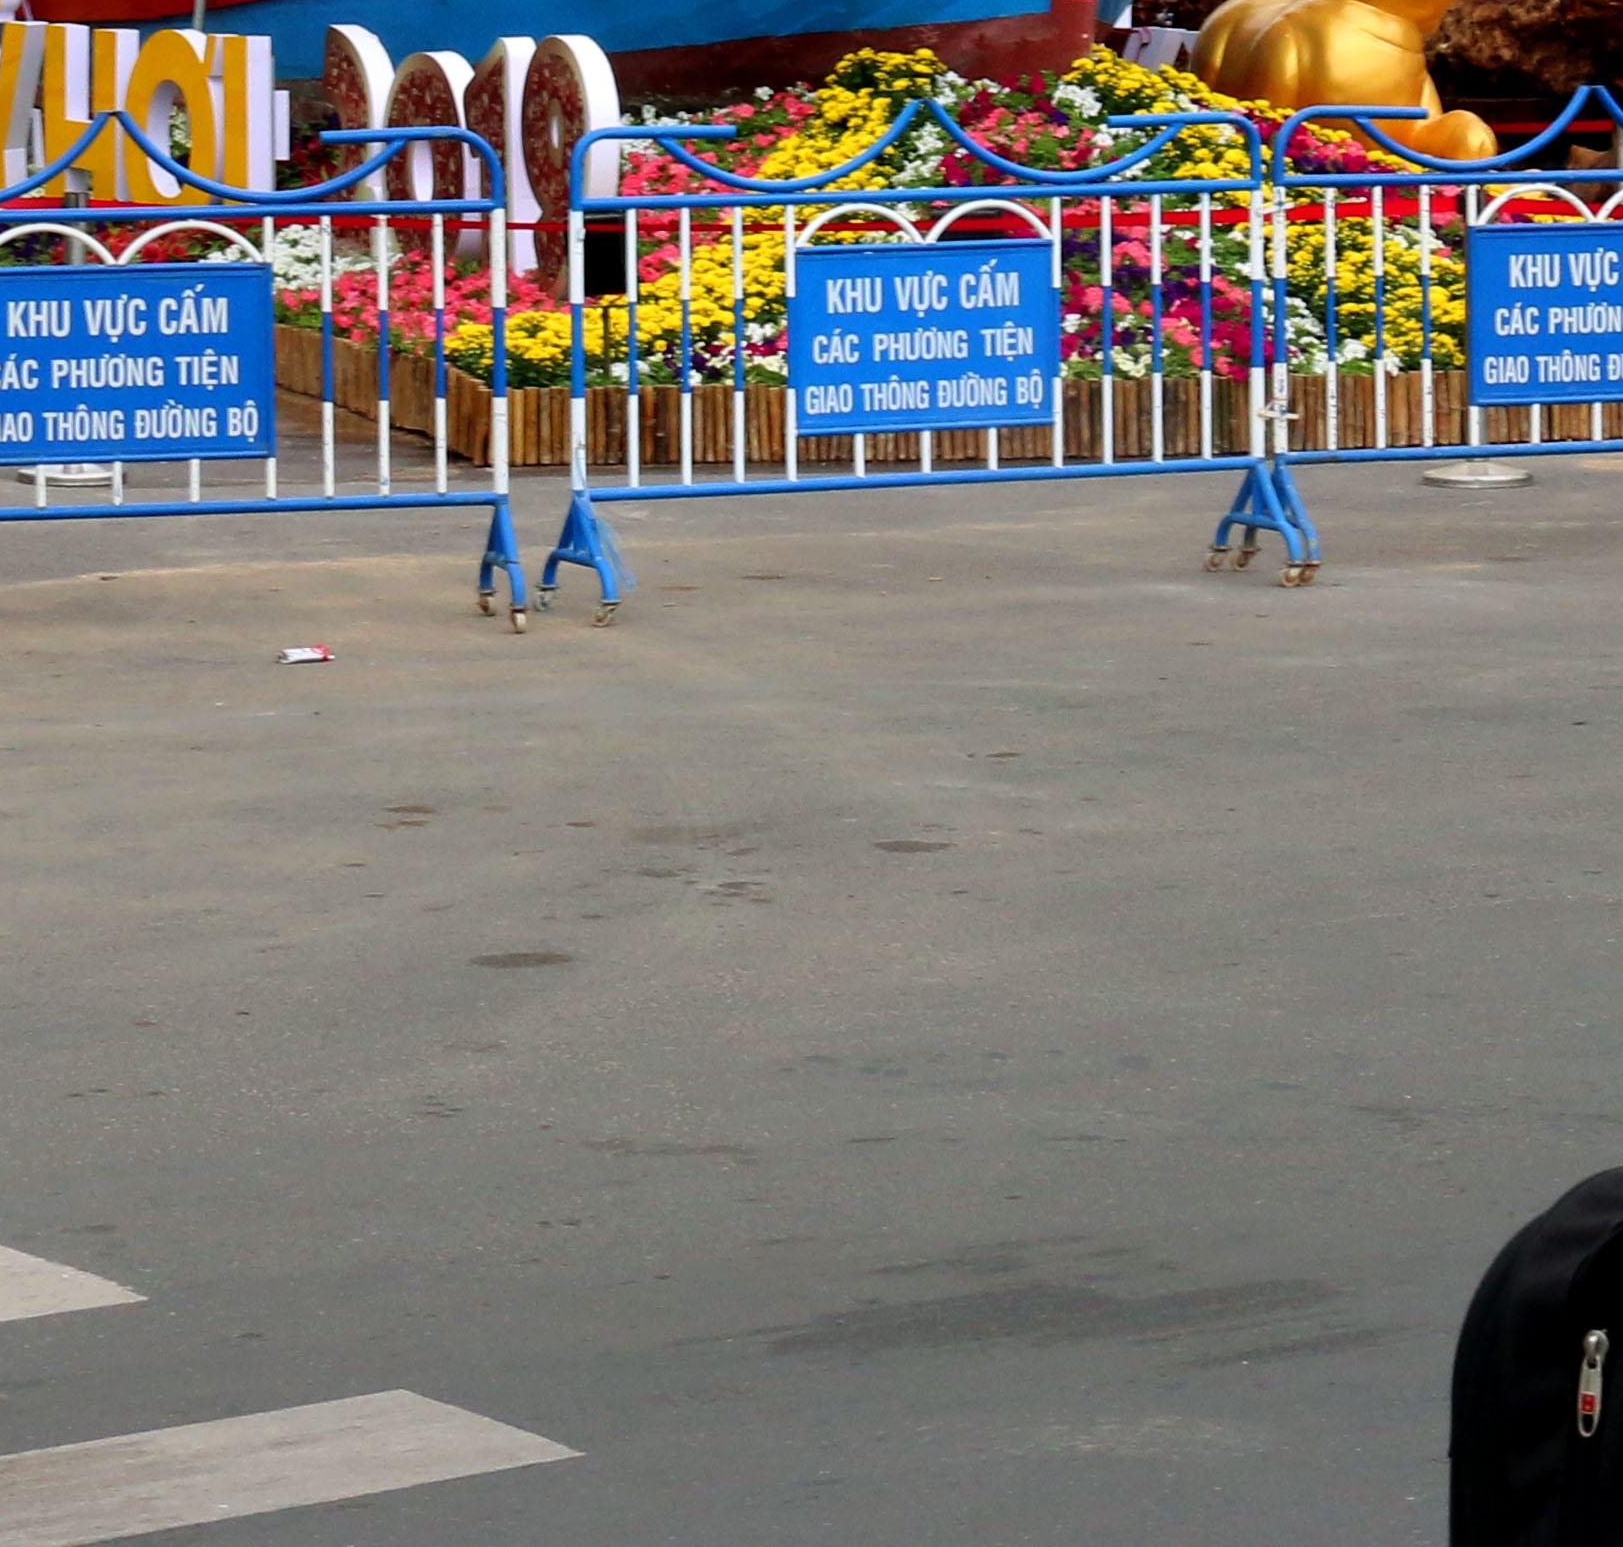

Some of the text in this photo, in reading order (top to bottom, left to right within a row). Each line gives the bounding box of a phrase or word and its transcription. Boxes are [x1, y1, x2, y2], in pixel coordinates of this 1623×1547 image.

[826, 258, 1021, 317] KHU VỰC CẤM
[1508, 253, 1562, 289] KHU
[1568, 247, 1620, 292] VỰC
[6, 283, 229, 343] KHU VỰC CẤM
[1494, 302, 1540, 336] CÁC
[812, 321, 1034, 365] CÁC PHƯƠNG TIỆN
[51, 353, 165, 389] PHƯƠNG
[174, 347, 239, 390] TIỆN
[1483, 355, 1530, 385] GIAO
[1535, 349, 1602, 383] THÔNG
[805, 368, 1044, 415] GIAO THÔNG ĐƯỜNG BỘ
[41, 403, 126, 442] THÔNG
[134, 399, 218, 440] ĐƯỜNG
[226, 399, 260, 444] BỘ
